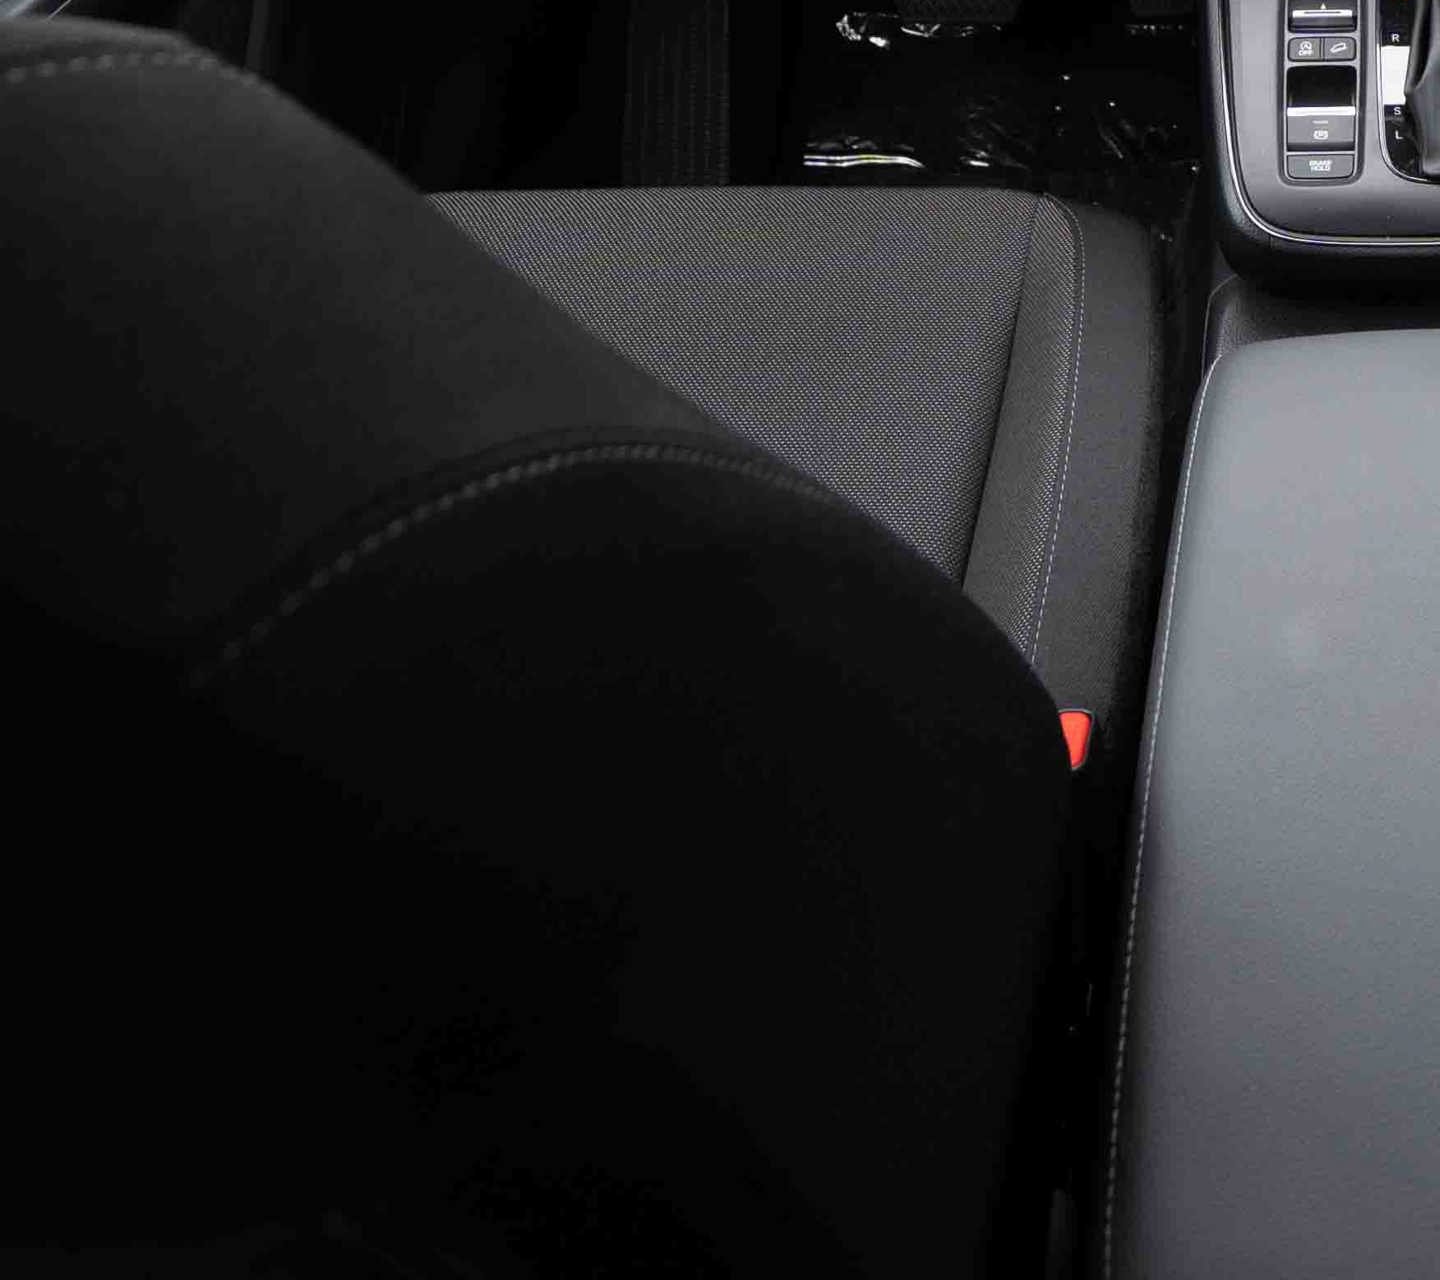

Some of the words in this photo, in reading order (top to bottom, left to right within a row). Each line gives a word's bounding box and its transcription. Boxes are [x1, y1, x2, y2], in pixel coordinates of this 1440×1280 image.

[1392, 33, 1400, 42] R
[1394, 106, 1402, 115] S
[1395, 130, 1403, 140] L
